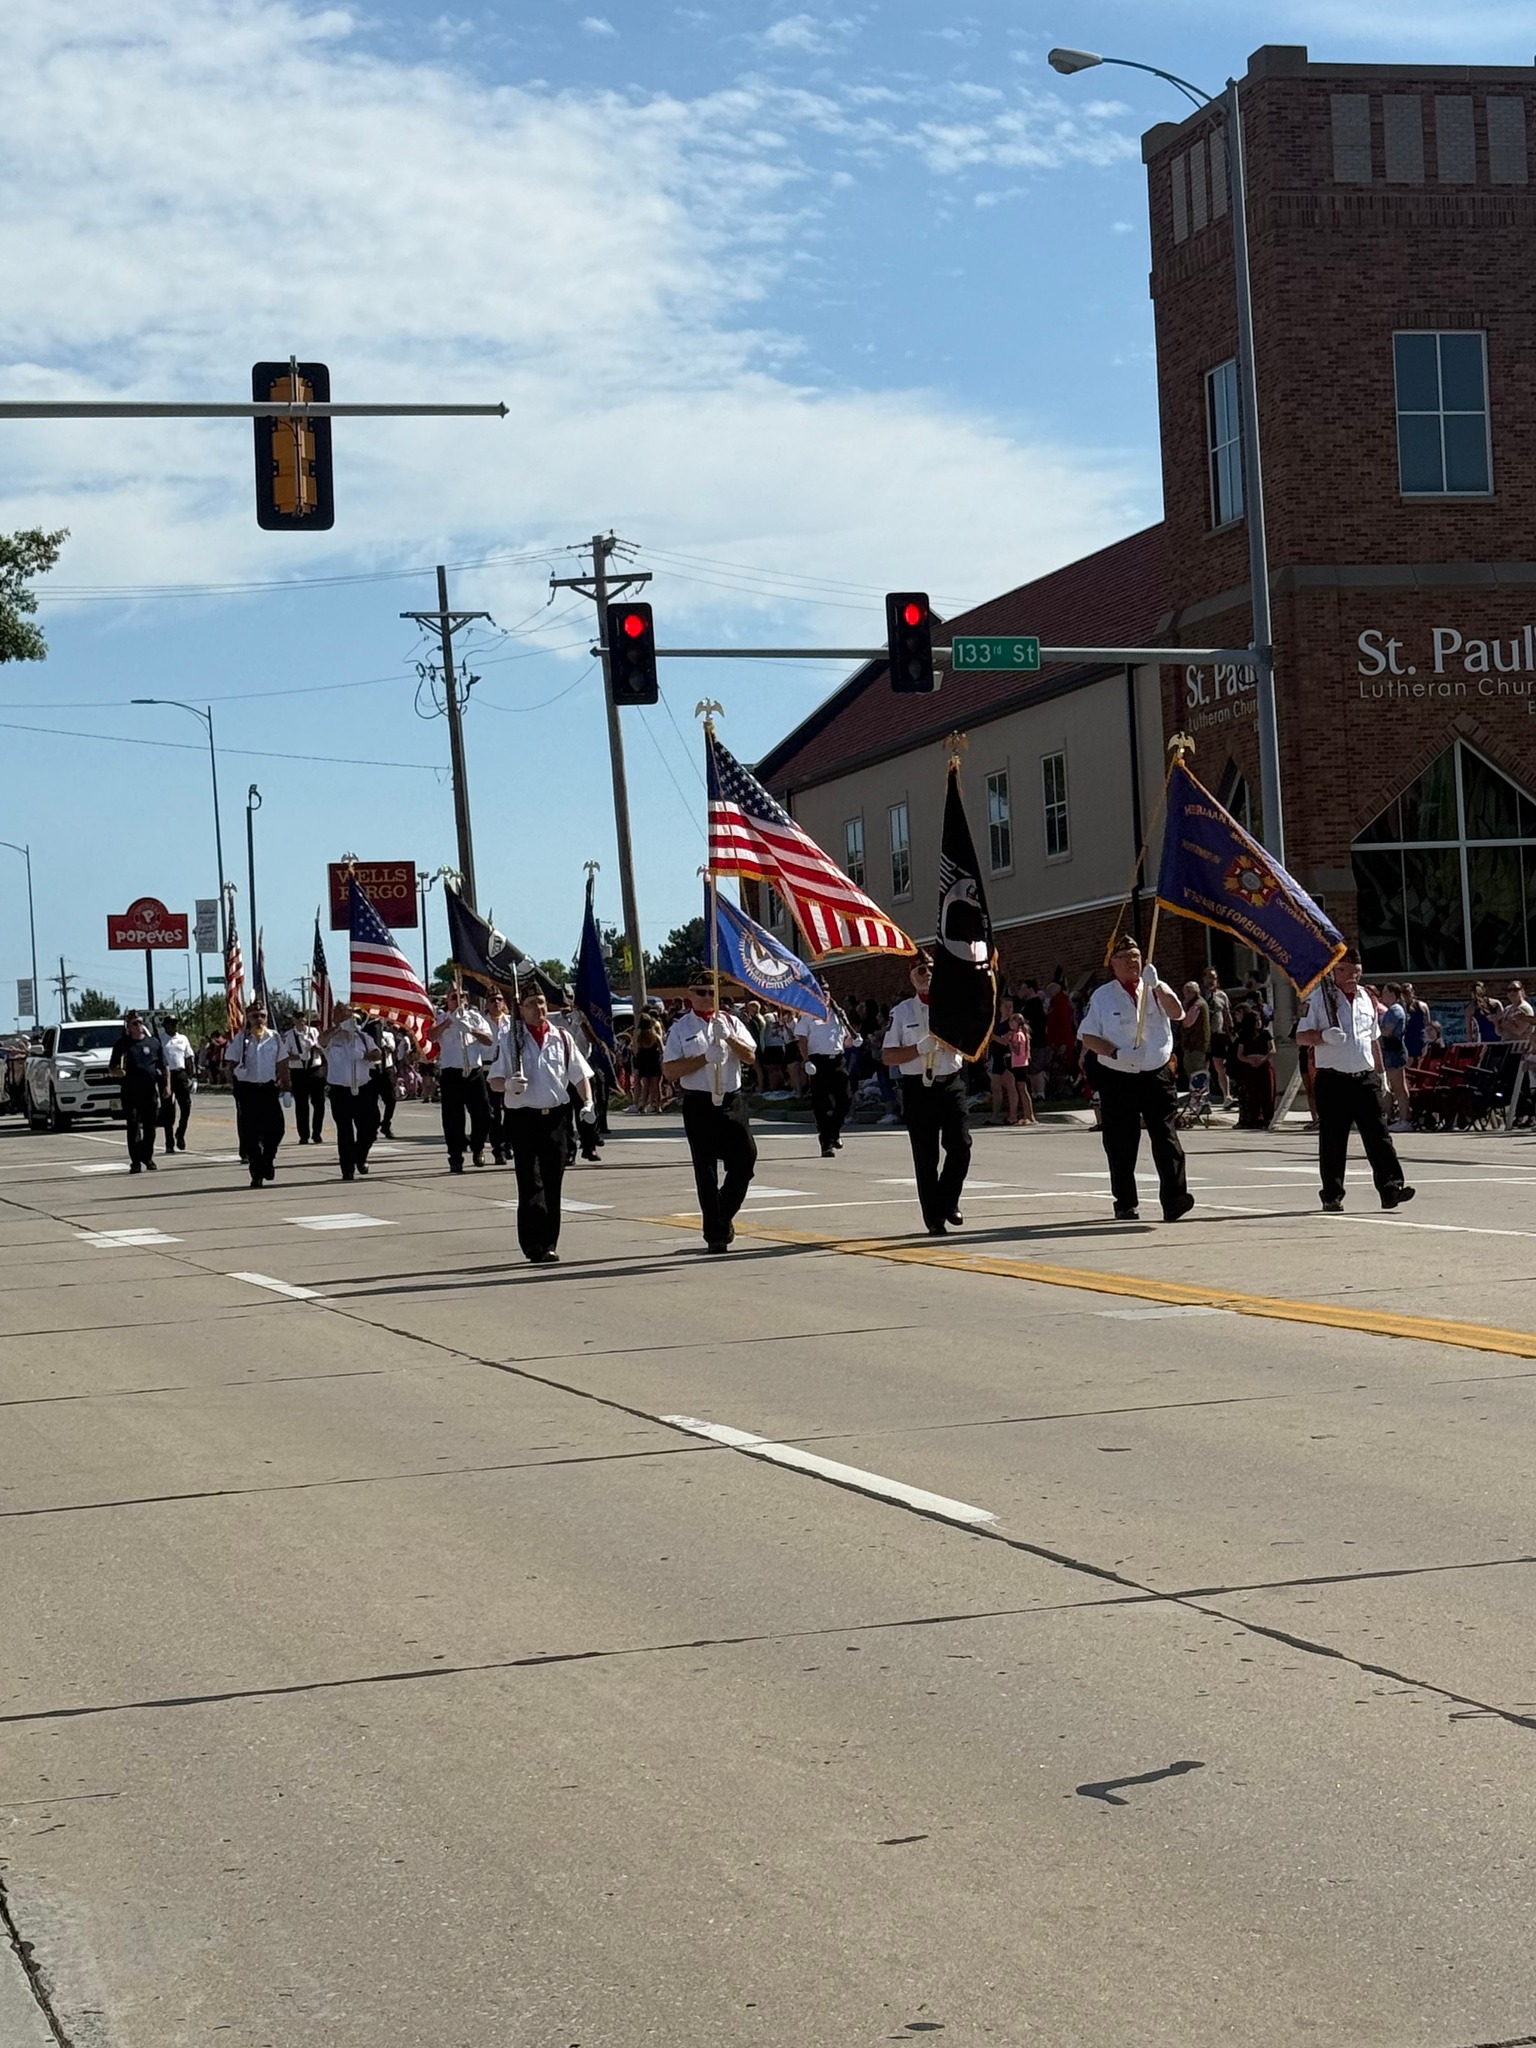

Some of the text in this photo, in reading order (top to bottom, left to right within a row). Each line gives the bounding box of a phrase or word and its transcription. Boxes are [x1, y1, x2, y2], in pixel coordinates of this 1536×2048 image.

[957, 643, 1035, 663] 133rd St
[1358, 624, 1536, 676] St. Paul
[1186, 664, 1257, 708] St. Paul
[1359, 677, 1536, 699] Lutheran Chur
[1233, 698, 1257, 719] Chur
[336, 868, 408, 884] WELLS
[339, 884, 408, 901] FRGO
[1215, 903, 1229, 917] OF
[1226, 907, 1270, 944] FOREIGN
[1266, 935, 1292, 964] WARS
